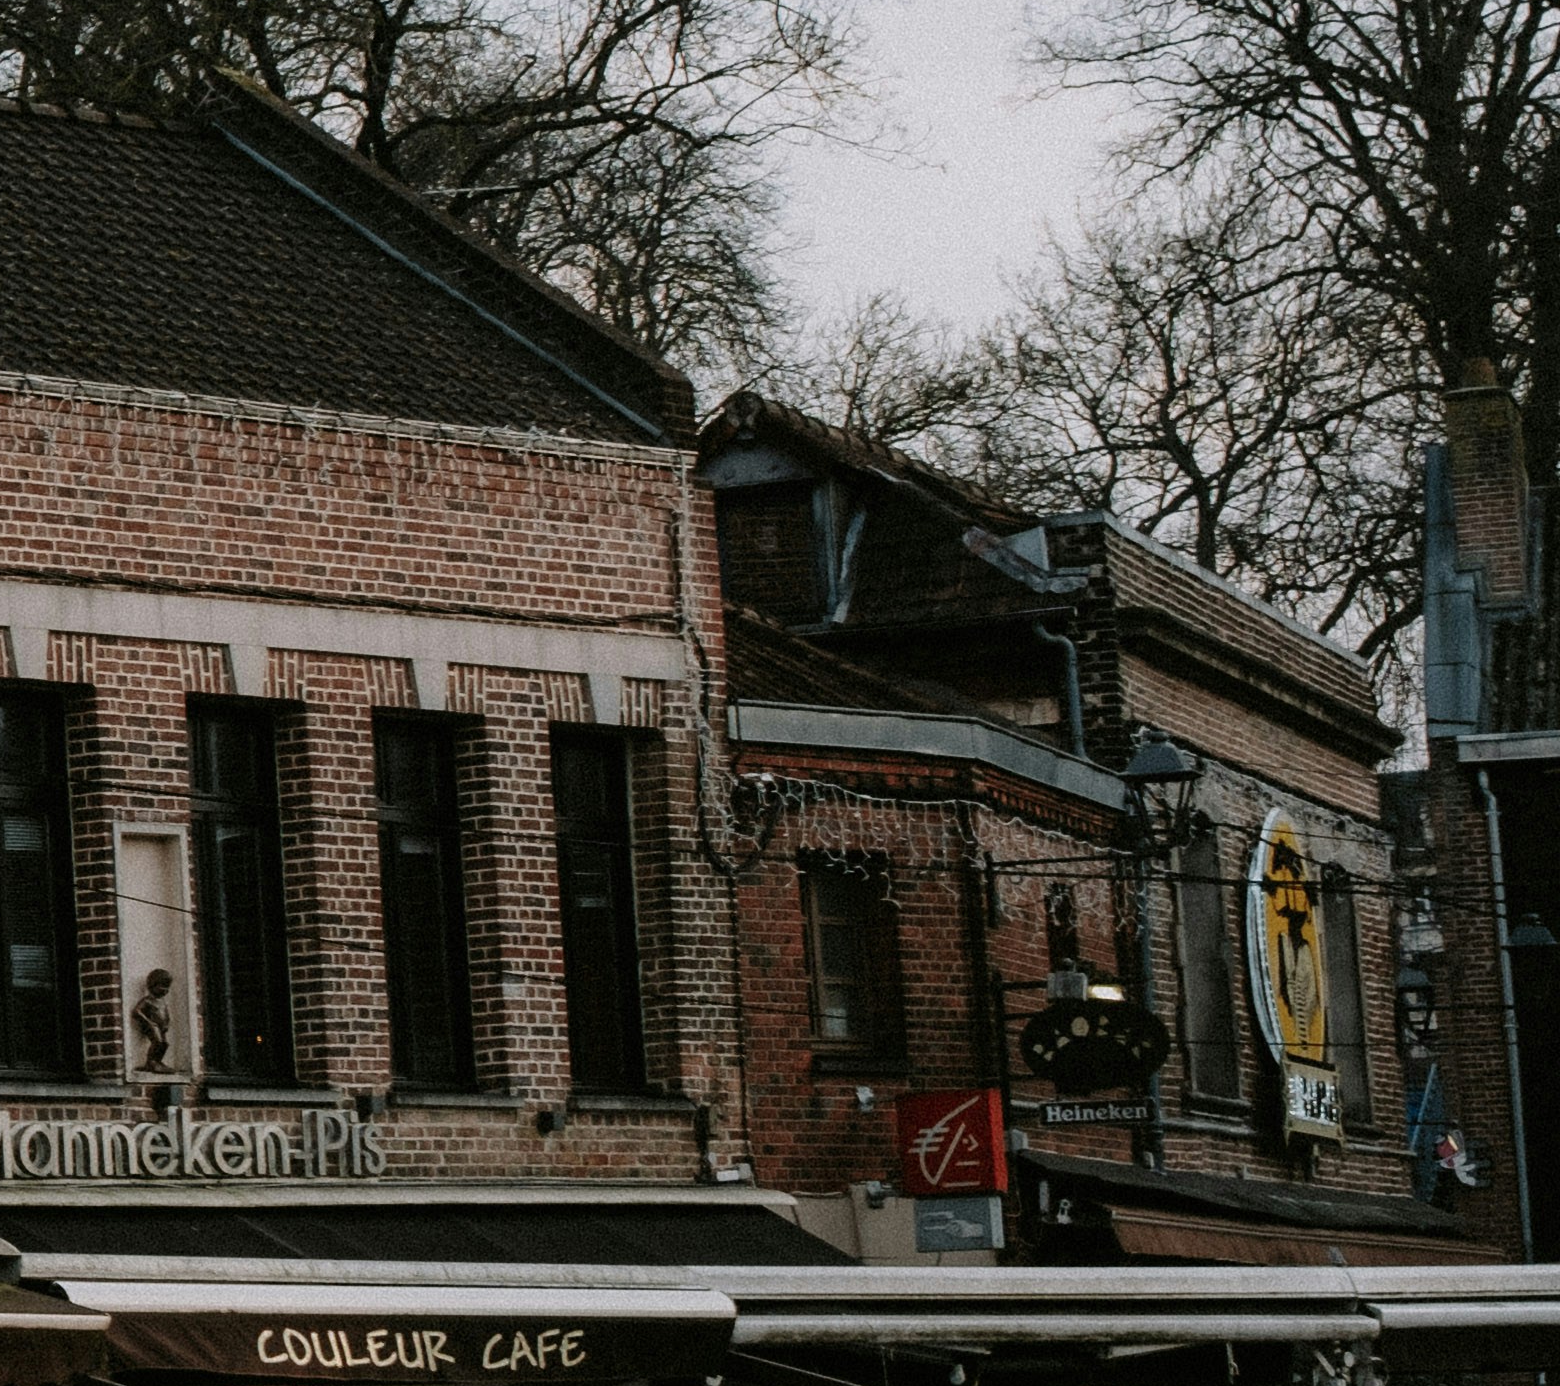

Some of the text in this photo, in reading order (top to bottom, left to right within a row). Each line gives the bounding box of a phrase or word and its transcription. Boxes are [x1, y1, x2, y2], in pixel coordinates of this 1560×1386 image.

[1045, 1102, 1149, 1124] Heineken
[256, 1328, 586, 1372] COULEUR CAFE
